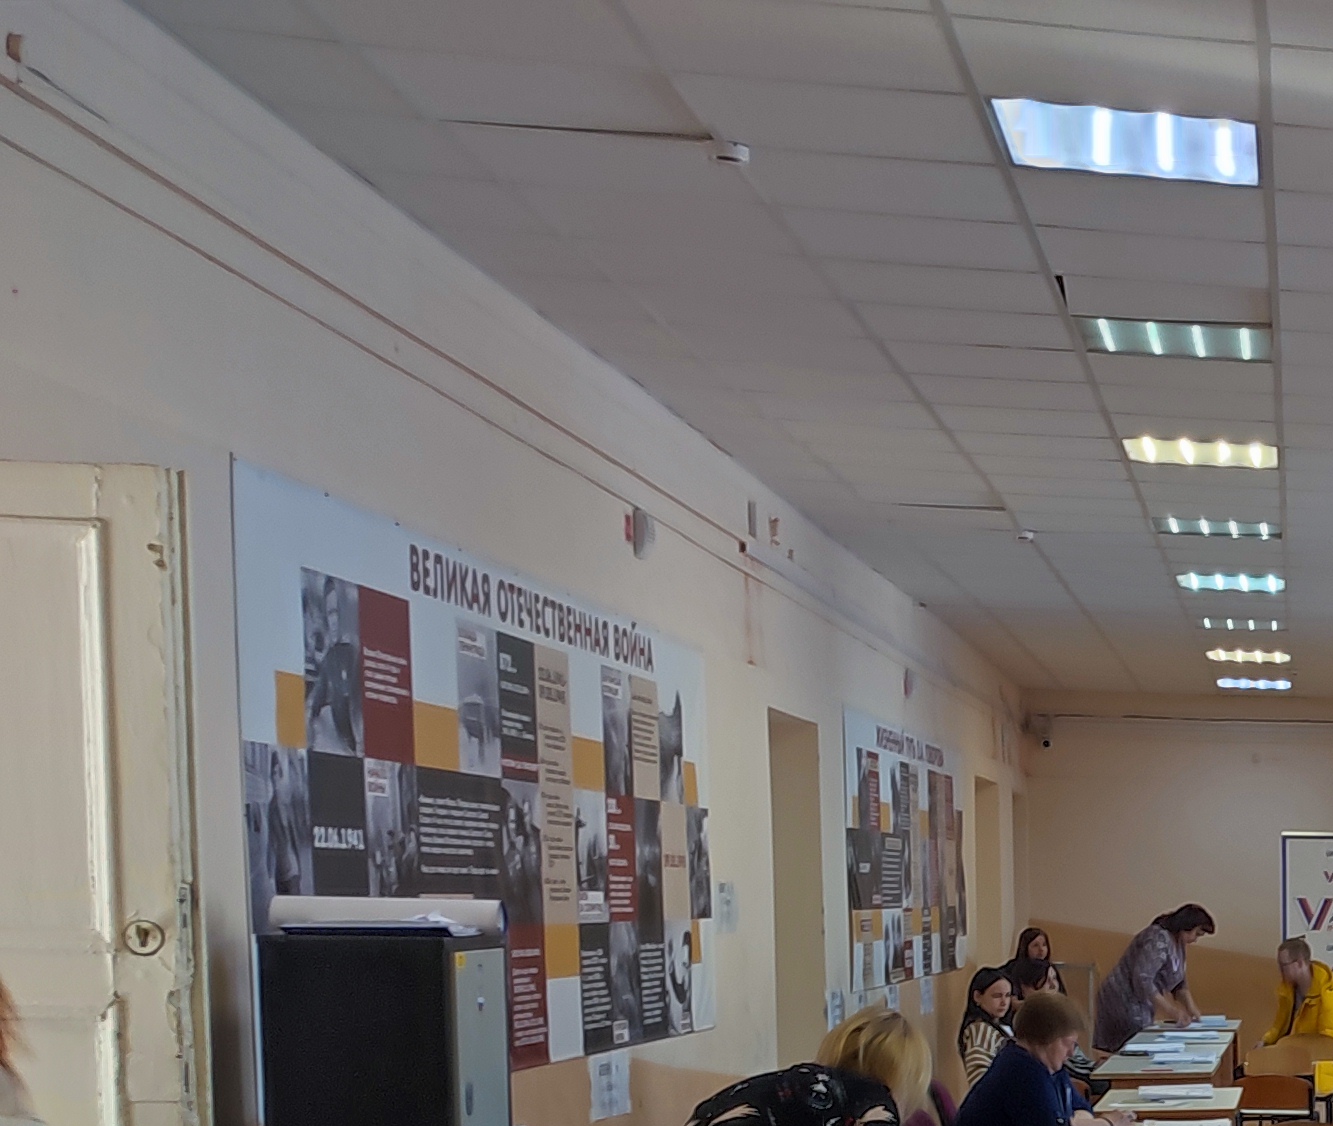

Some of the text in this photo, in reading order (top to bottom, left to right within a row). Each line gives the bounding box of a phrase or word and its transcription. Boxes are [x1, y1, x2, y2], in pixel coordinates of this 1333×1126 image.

[409, 543, 655, 674] ВЕЛИКАЯ ОТЕЧЕСТВЕННАЯ ВОЙНА
